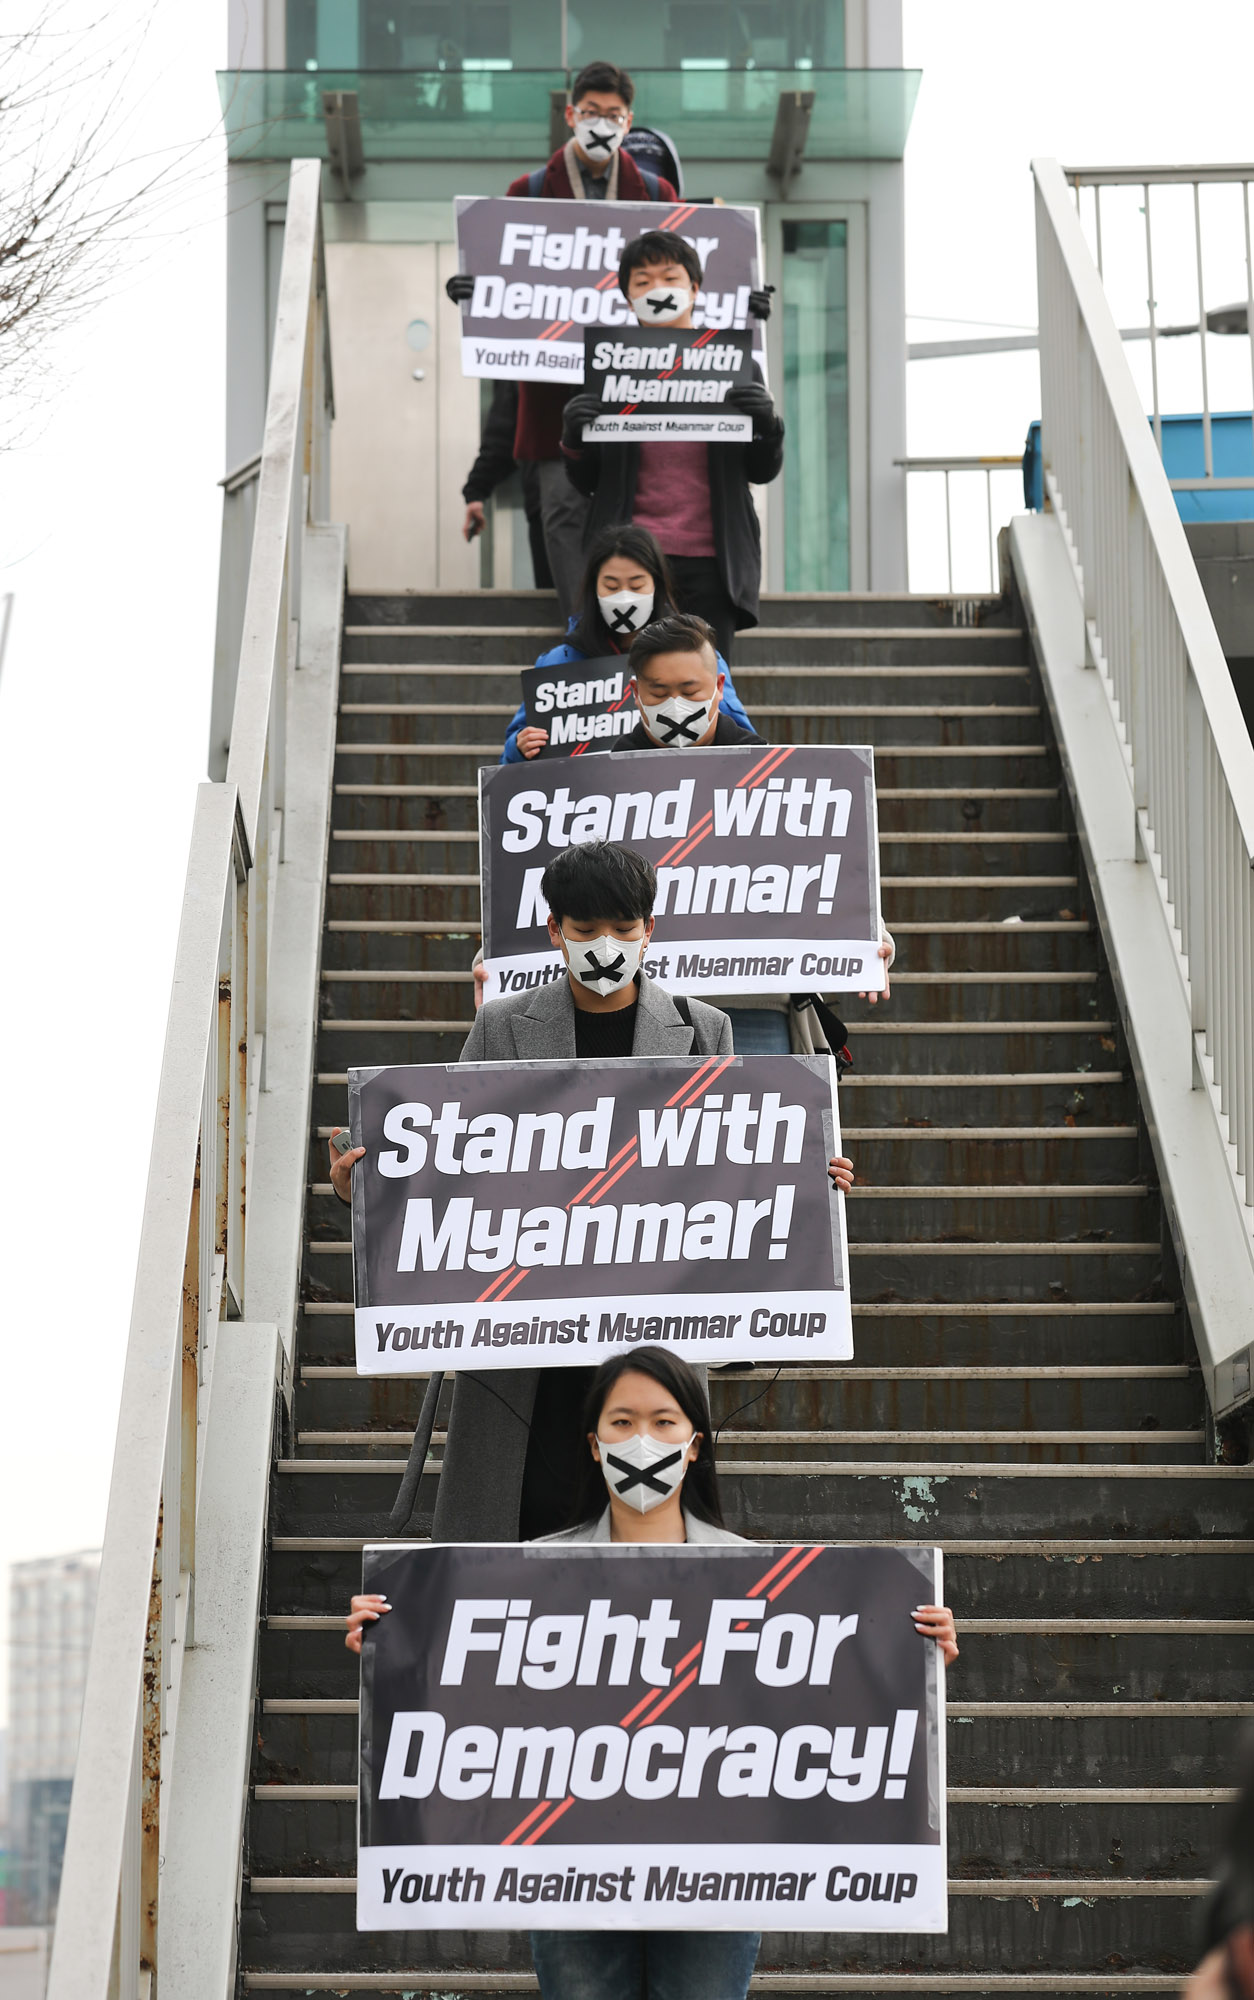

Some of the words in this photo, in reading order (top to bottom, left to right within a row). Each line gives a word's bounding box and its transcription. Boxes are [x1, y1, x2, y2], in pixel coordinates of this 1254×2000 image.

[499, 222, 626, 271] Fight
[474, 347, 530, 367] Youth
[592, 342, 678, 371] Stand
[682, 343, 744, 372] with
[601, 374, 734, 404] Myanmar
[622, 421, 661, 432] Against
[664, 422, 714, 433] Myanmar
[716, 421, 745, 433] Coup
[534, 671, 624, 713] Stand
[501, 778, 697, 855] Stand
[713, 777, 853, 838] with
[515, 853, 842, 930] Mnmar!
[675, 956, 795, 981] Myanmar
[799, 952, 864, 978] Coup
[376, 1096, 616, 1179] Stand
[638, 1092, 808, 1169] with
[396, 1184, 797, 1274] Myanmar!
[375, 1319, 464, 1354] Youth
[470, 1313, 591, 1348] Against
[596, 1312, 743, 1344] Myanmar
[749, 1308, 828, 1340] Coup
[439, 1599, 681, 1691] Fight
[698, 1599, 859, 1687] For
[378, 1709, 919, 1803] Democracy!
[382, 1867, 486, 1904] Youth
[494, 1866, 636, 1903] Against
[643, 1866, 817, 1904] Myanmar
[825, 1865, 918, 1904] Coup
